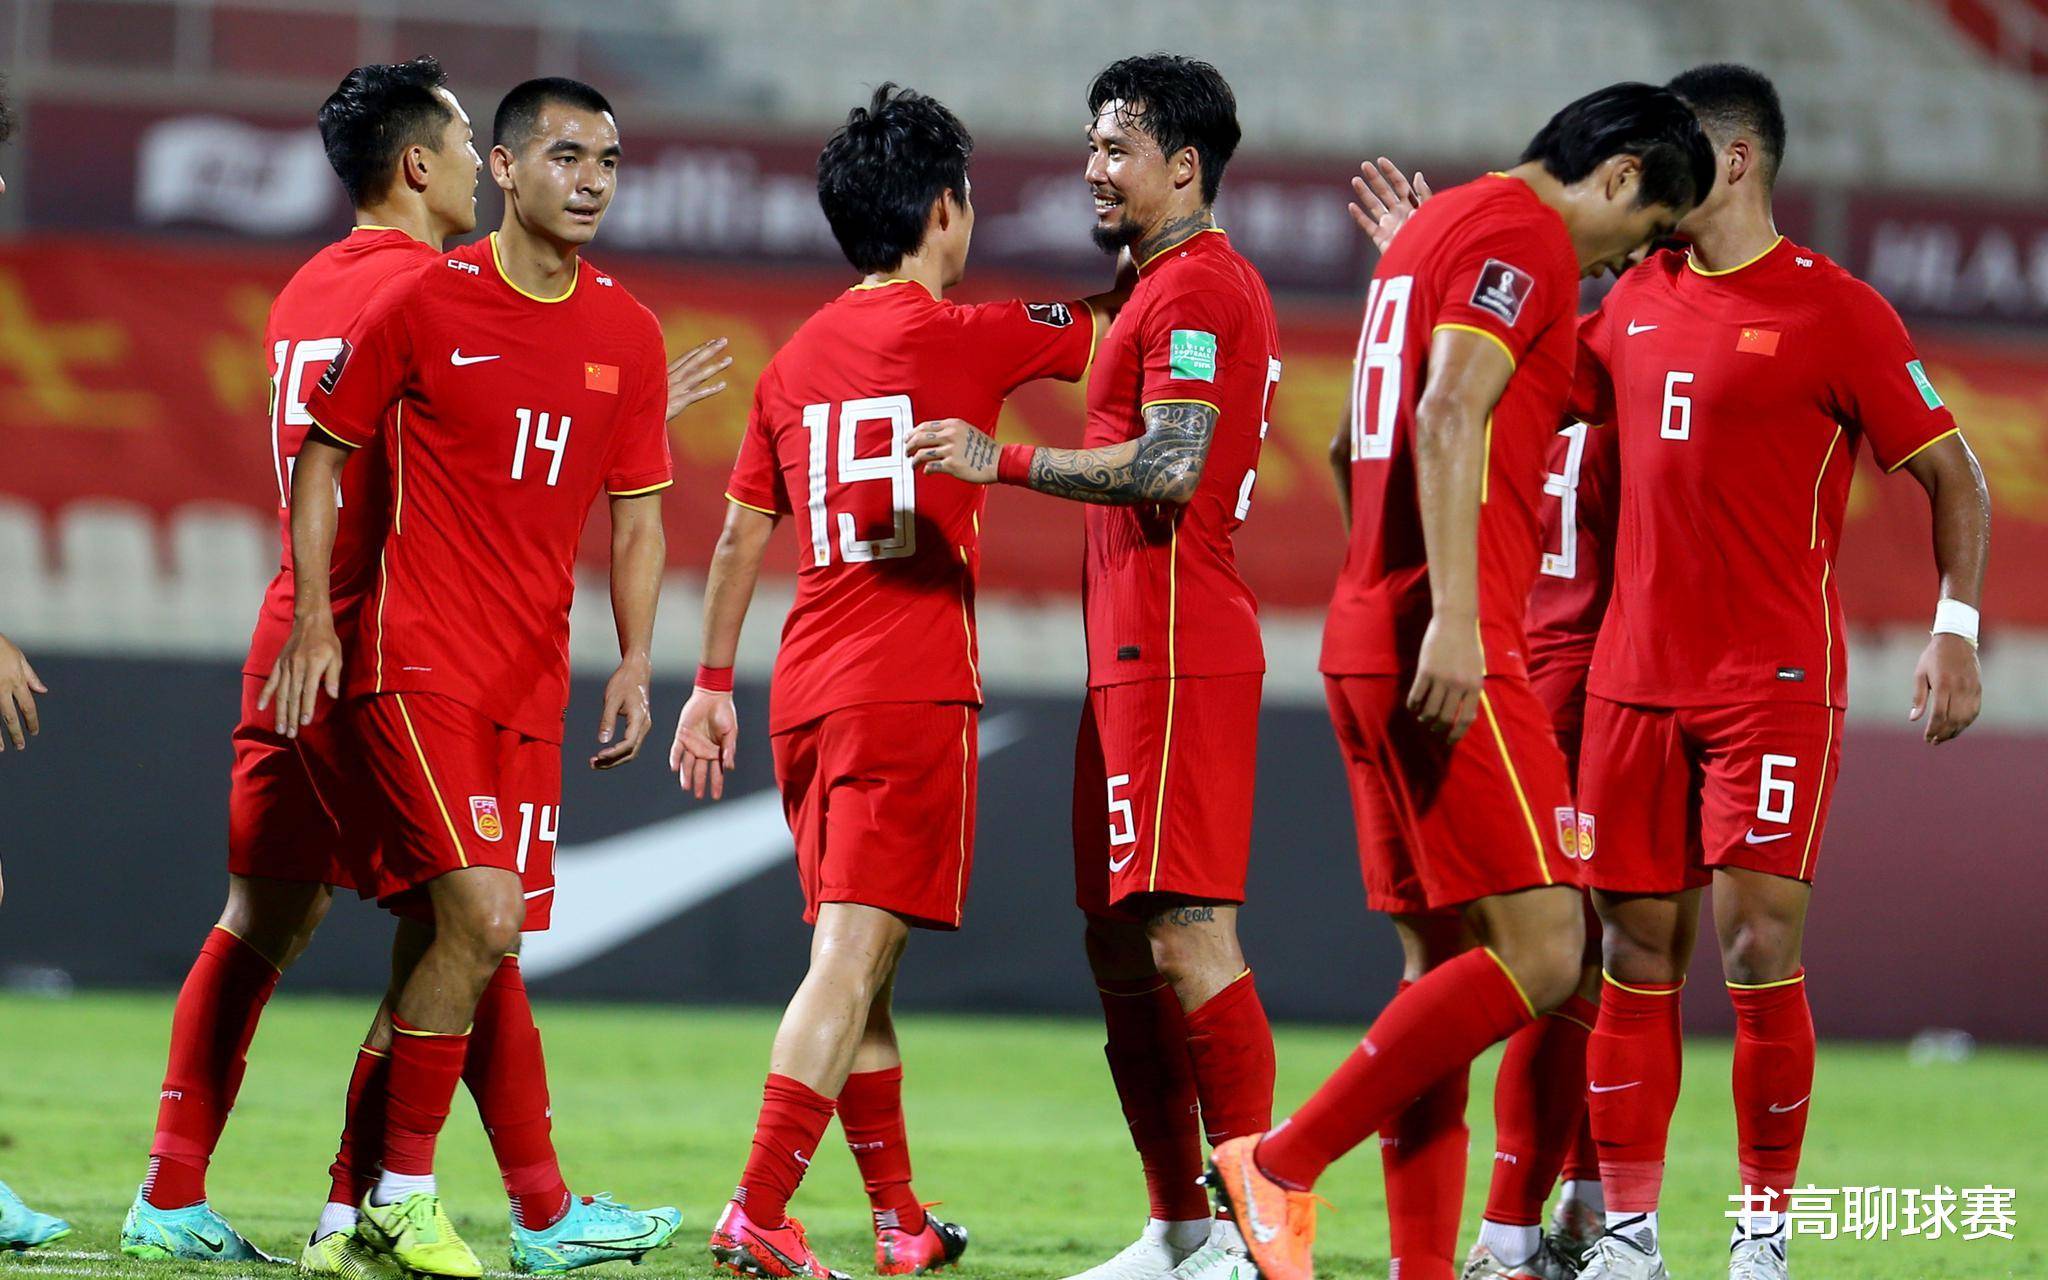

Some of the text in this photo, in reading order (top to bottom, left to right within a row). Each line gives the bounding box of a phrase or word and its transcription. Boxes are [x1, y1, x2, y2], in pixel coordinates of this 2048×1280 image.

[447, 259, 480, 275] CFA
[1174, 343, 1212, 354] LIVING
[1351, 275, 1414, 461] 18
[1659, 370, 1695, 441] 6
[511, 407, 572, 486] 14
[802, 394, 916, 567] 19
[1107, 773, 1136, 846] 5
[1756, 753, 1797, 825] 6
[516, 802, 560, 876] 14
